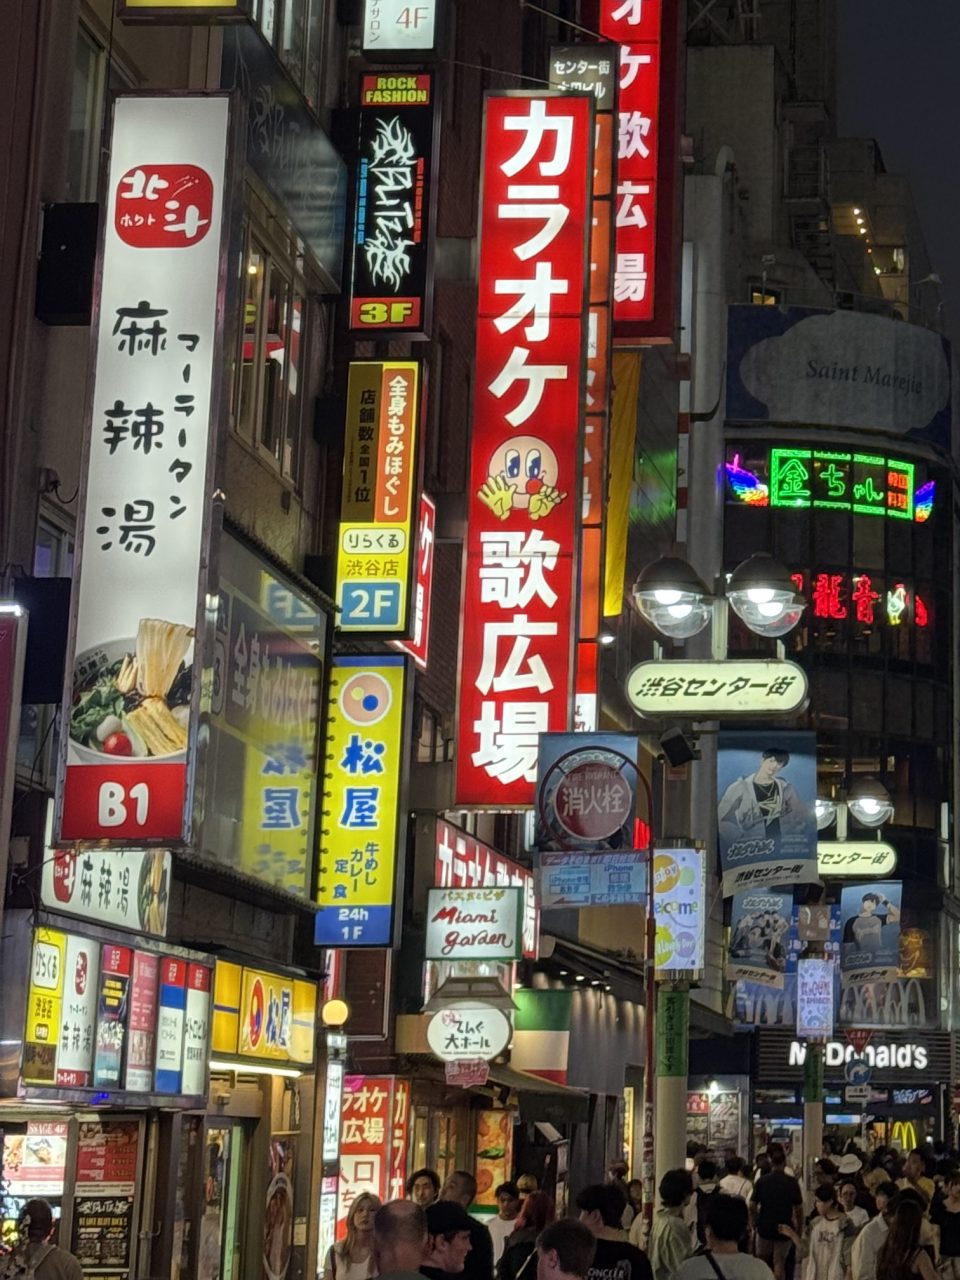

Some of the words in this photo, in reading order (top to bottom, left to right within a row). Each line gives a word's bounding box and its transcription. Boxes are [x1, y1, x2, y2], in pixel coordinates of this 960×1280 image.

[395, 7, 429, 29] 4F
[554, 61, 610, 75] センター街
[377, 77, 416, 90] ROCK
[365, 90, 427, 104] FASHION
[488, 100, 574, 428] カラオケ
[359, 303, 413, 324] 3F
[806, 359, 858, 382] Saint
[97, 300, 168, 557] 麻辣湯
[168, 333, 200, 520] マーラータン
[383, 375, 408, 516] 全身もみほぐし
[778, 459, 884, 502] 金ちゃん
[348, 534, 400, 549] りらくる
[346, 559, 399, 577] 渋谷店
[349, 589, 394, 619] 2F
[471, 529, 560, 786] 歌広場
[635, 675, 797, 698] 渋谷センター街
[339, 734, 384, 829] 松屋
[98, 781, 149, 827] B1
[562, 783, 625, 818] 消火栓
[365, 841, 380, 886] 牛めし
[604, 864, 633, 872] iPhone
[819, 851, 889, 865] センター街
[333, 859, 349, 899] 定食
[351, 849, 363, 892] カレー
[654, 862, 678, 884] njoy
[339, 909, 369, 921] 24h
[431, 905, 498, 924] Miami
[654, 899, 699, 915] elcome
[341, 926, 363, 940] 1F
[36, 952, 57, 979] りらくる
[453, 1020, 484, 1034] てんぐ
[444, 1033, 491, 1050] 大ホール
[789, 1041, 928, 1070] MDonald's
[342, 1086, 388, 1113] ラオケ
[29, 1123, 52, 1134] SSAGE
[341, 1117, 384, 1145] 広場
